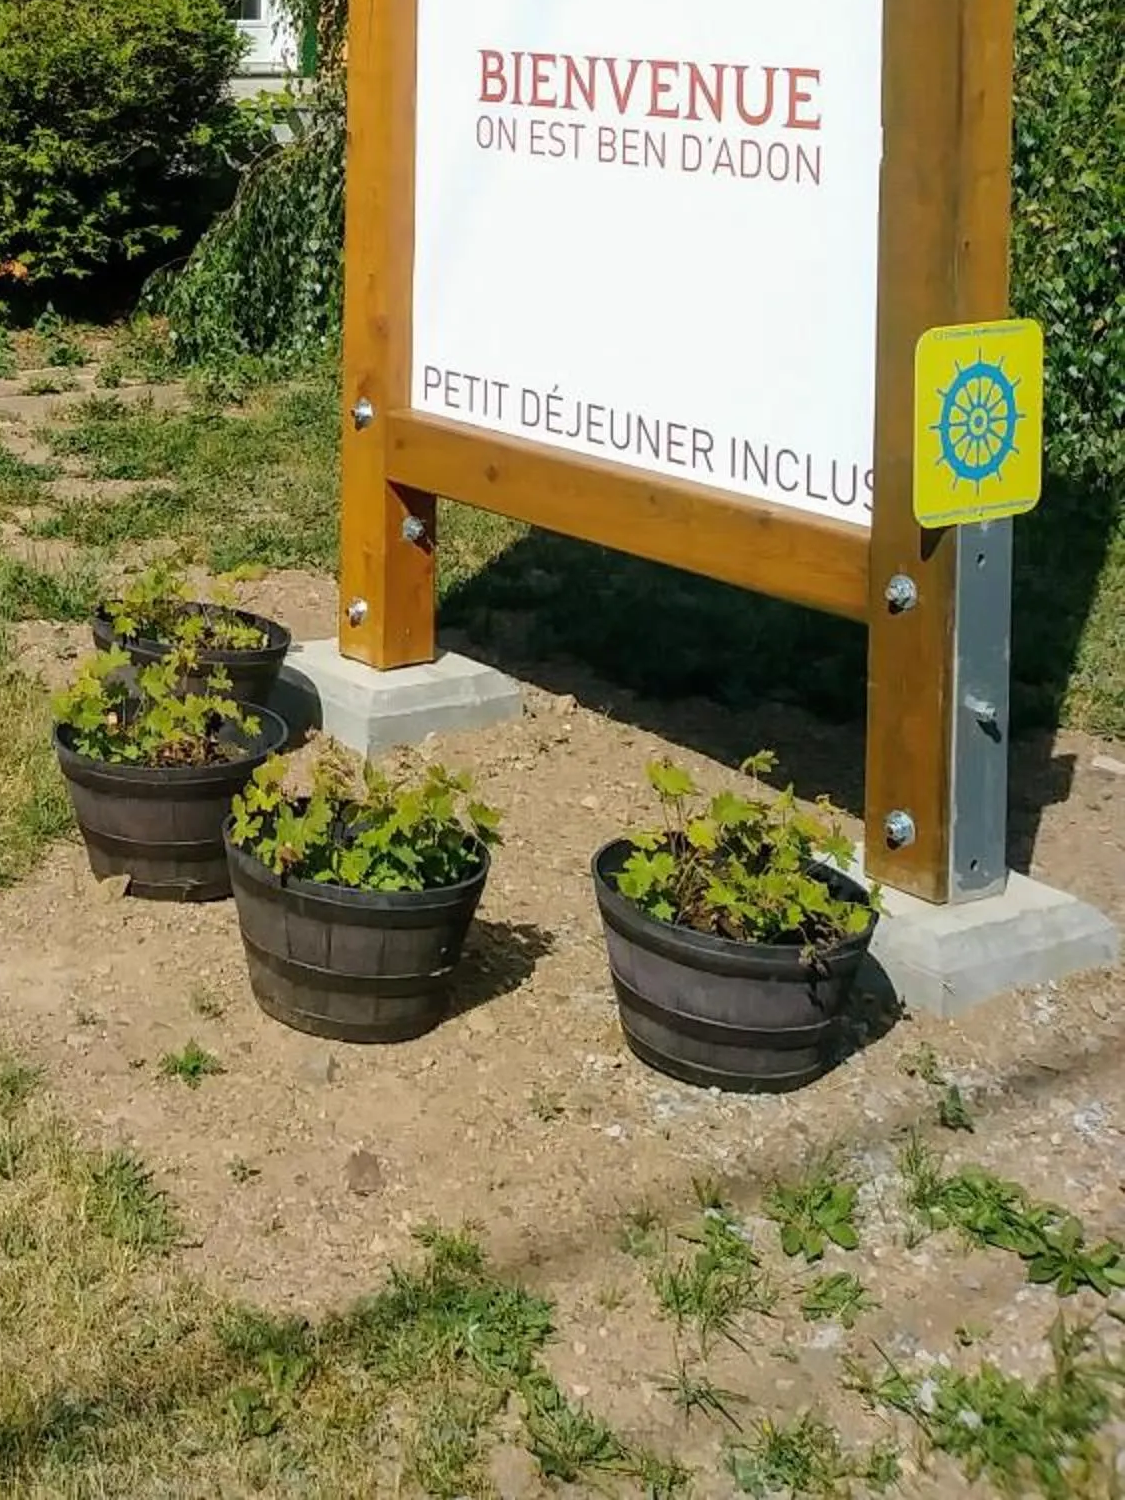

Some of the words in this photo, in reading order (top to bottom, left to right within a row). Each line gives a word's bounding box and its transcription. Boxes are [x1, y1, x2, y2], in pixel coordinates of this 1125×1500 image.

[477, 49, 822, 130] BIENVENUE
[476, 116, 517, 153] ON
[530, 120, 586, 159] EST
[598, 126, 666, 169] BEN
[681, 134, 821, 186] D'ADON
[423, 365, 510, 420] PETIT
[520, 385, 714, 473] DÉJEUNER
